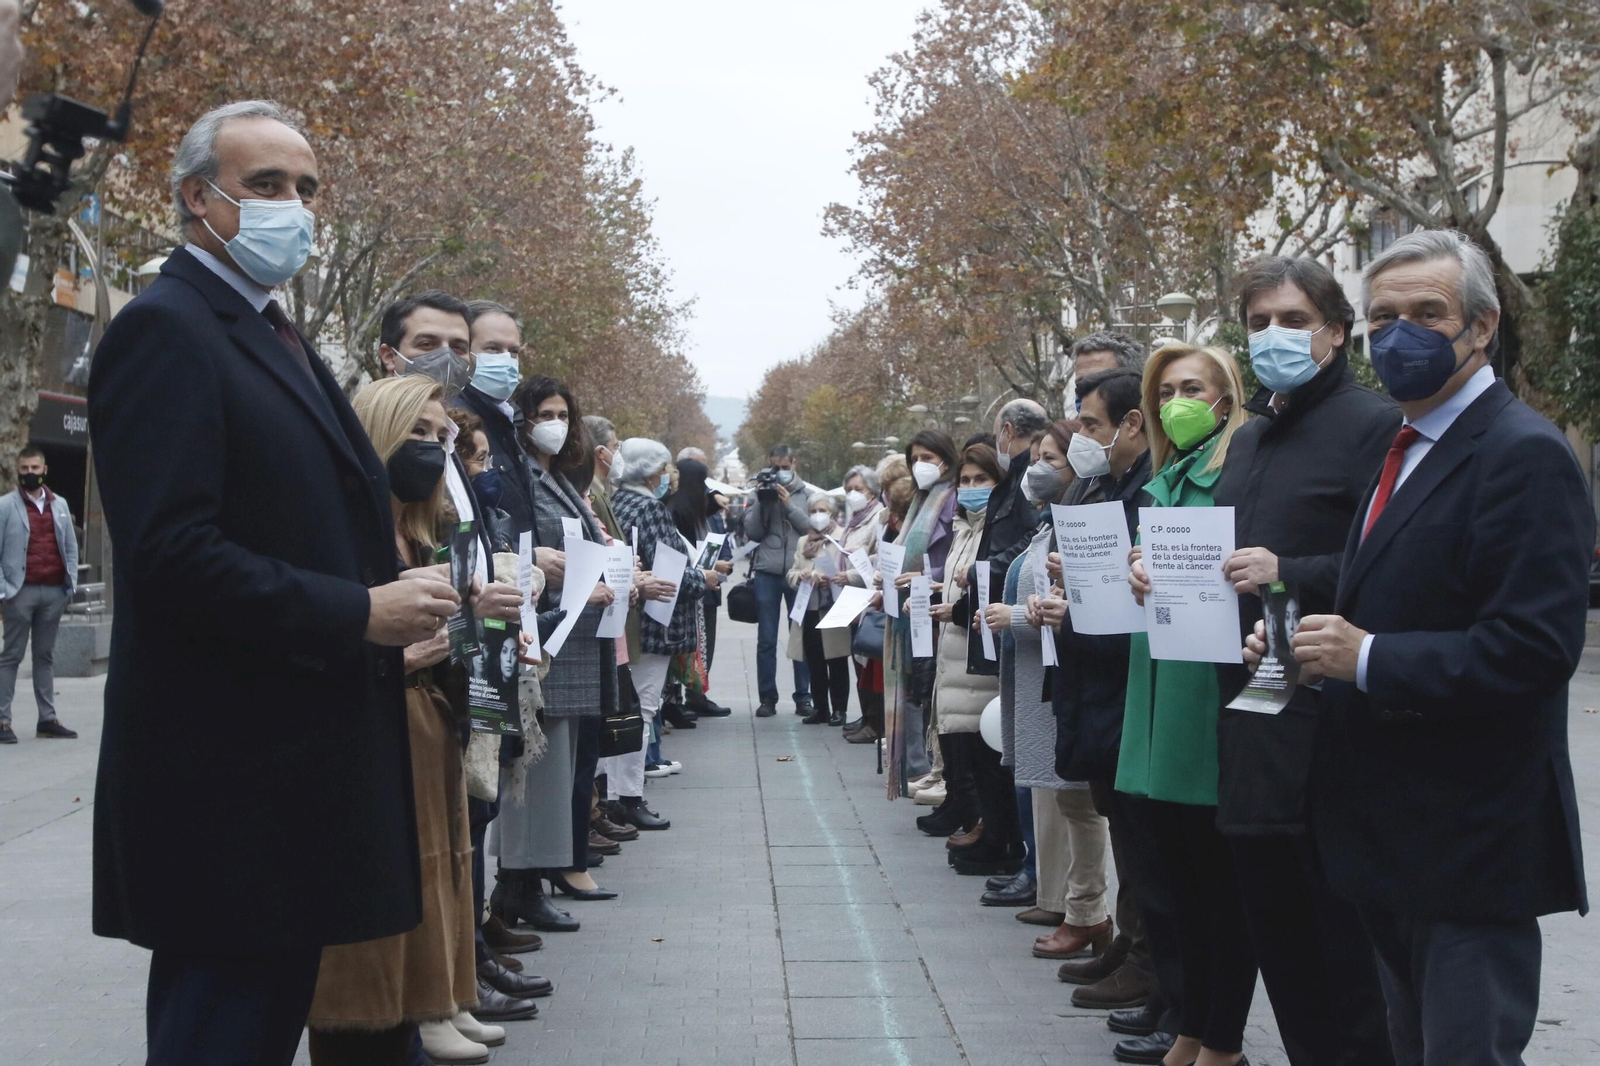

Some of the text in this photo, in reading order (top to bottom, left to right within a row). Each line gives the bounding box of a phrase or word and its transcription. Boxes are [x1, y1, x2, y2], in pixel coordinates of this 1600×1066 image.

[63, 410, 88, 435] cajasur
[1150, 525, 1165, 534] C.P.
[1088, 533, 1118, 542] frontera
[1067, 543, 1074, 551] la
[1074, 541, 1118, 552] desigualdad
[1151, 543, 1170, 552] Esta,
[1181, 543, 1189, 552] la
[1190, 543, 1222, 552] frontera
[1063, 550, 1078, 558] frente
[1086, 550, 1113, 558] cáncer.
[1151, 553, 1221, 562] de la desigualdad
[1152, 561, 1214, 570] frente al cáncer.
[483, 685, 498, 693] iguales
